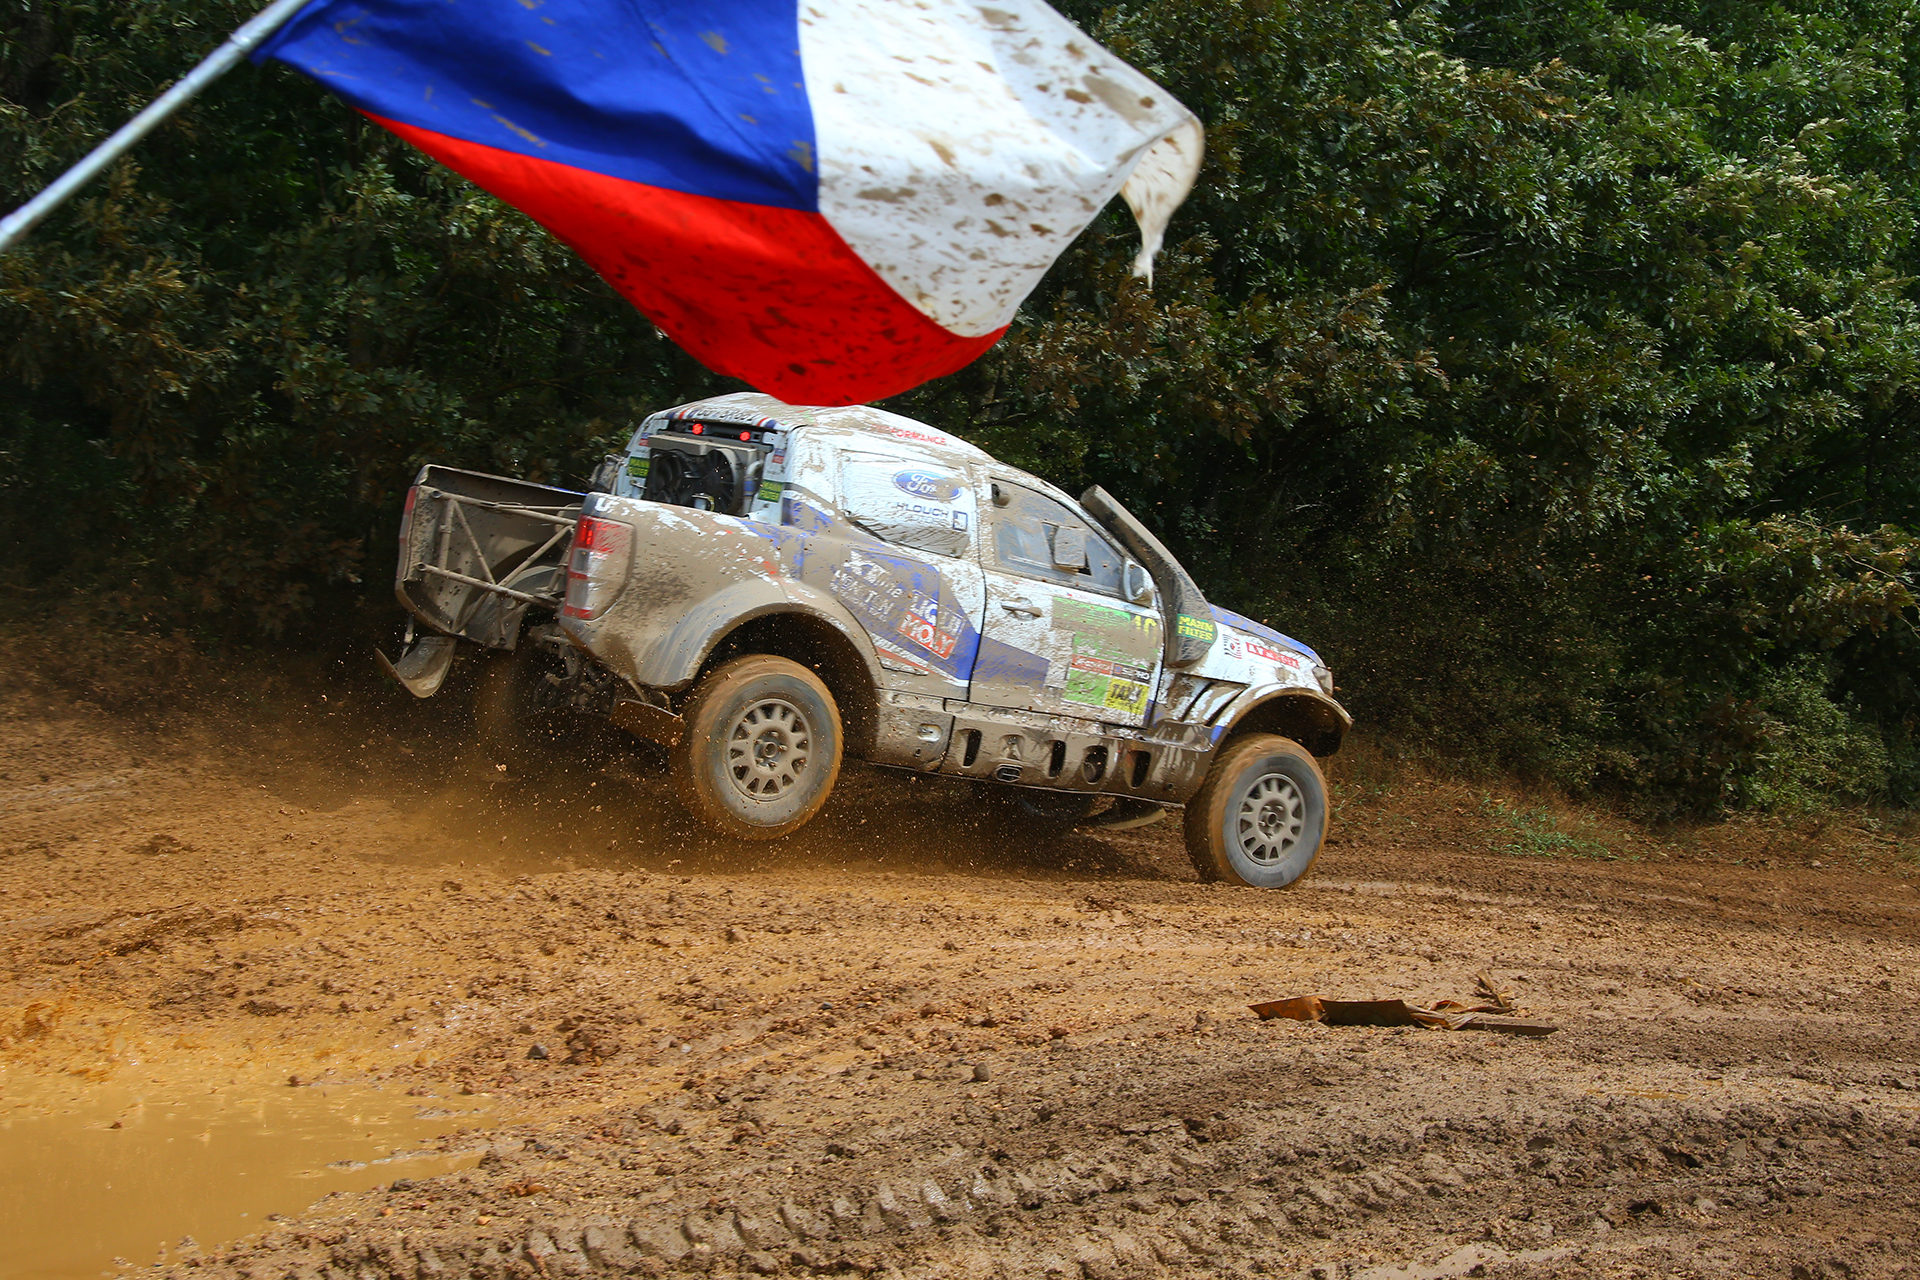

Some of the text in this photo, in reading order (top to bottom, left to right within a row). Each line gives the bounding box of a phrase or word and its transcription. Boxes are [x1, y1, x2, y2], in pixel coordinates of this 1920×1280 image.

[1177, 625, 1213, 641] FILTER
[1178, 615, 1214, 633] MANN
[899, 613, 954, 655] MOLY
